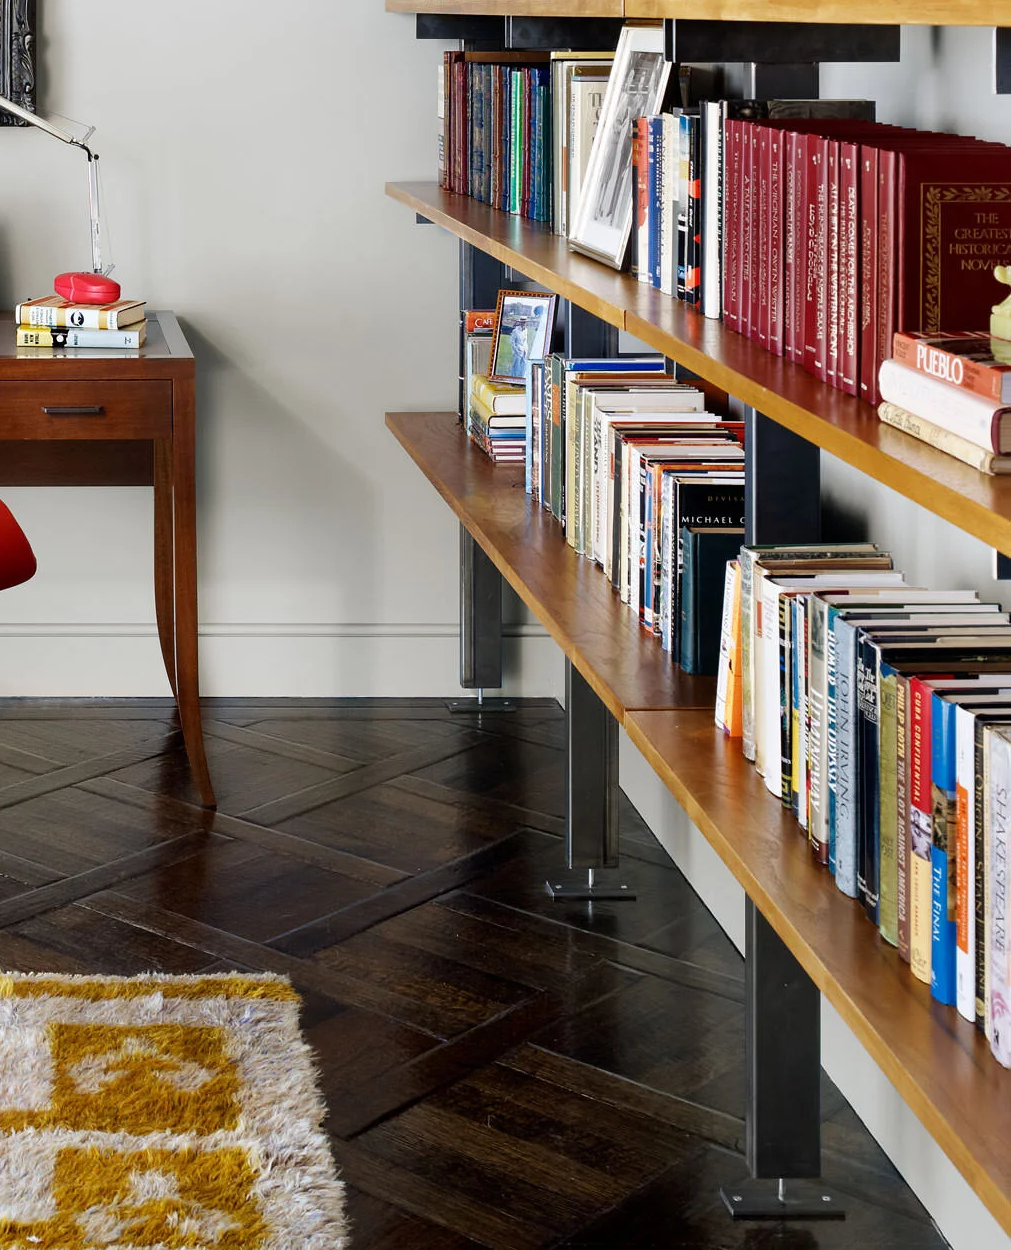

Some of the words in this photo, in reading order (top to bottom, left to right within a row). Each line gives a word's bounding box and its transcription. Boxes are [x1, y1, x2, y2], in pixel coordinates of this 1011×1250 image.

[974, 212, 999, 224] THE
[846, 297, 854, 356] ARCHBISHOP
[916, 344, 964, 385] PUEBLO
[681, 516, 733, 524] MICHAEL
[840, 671, 849, 732] JOHN
[897, 683, 905, 722] PHILIP
[810, 686, 824, 812] HEMINGWAY
[897, 725, 905, 759] ROTH
[840, 739, 849, 819] IRVING
[897, 759, 905, 782] THE
[898, 784, 906, 813] PLOT
[975, 773, 984, 841] ORIGIN
[898, 816, 906, 869] AGAINST
[898, 869, 906, 922] AMERICA
[933, 867, 942, 896] THE
[975, 860, 985, 914] SATAN
[995, 786, 1007, 955] SHAKESPEARE
